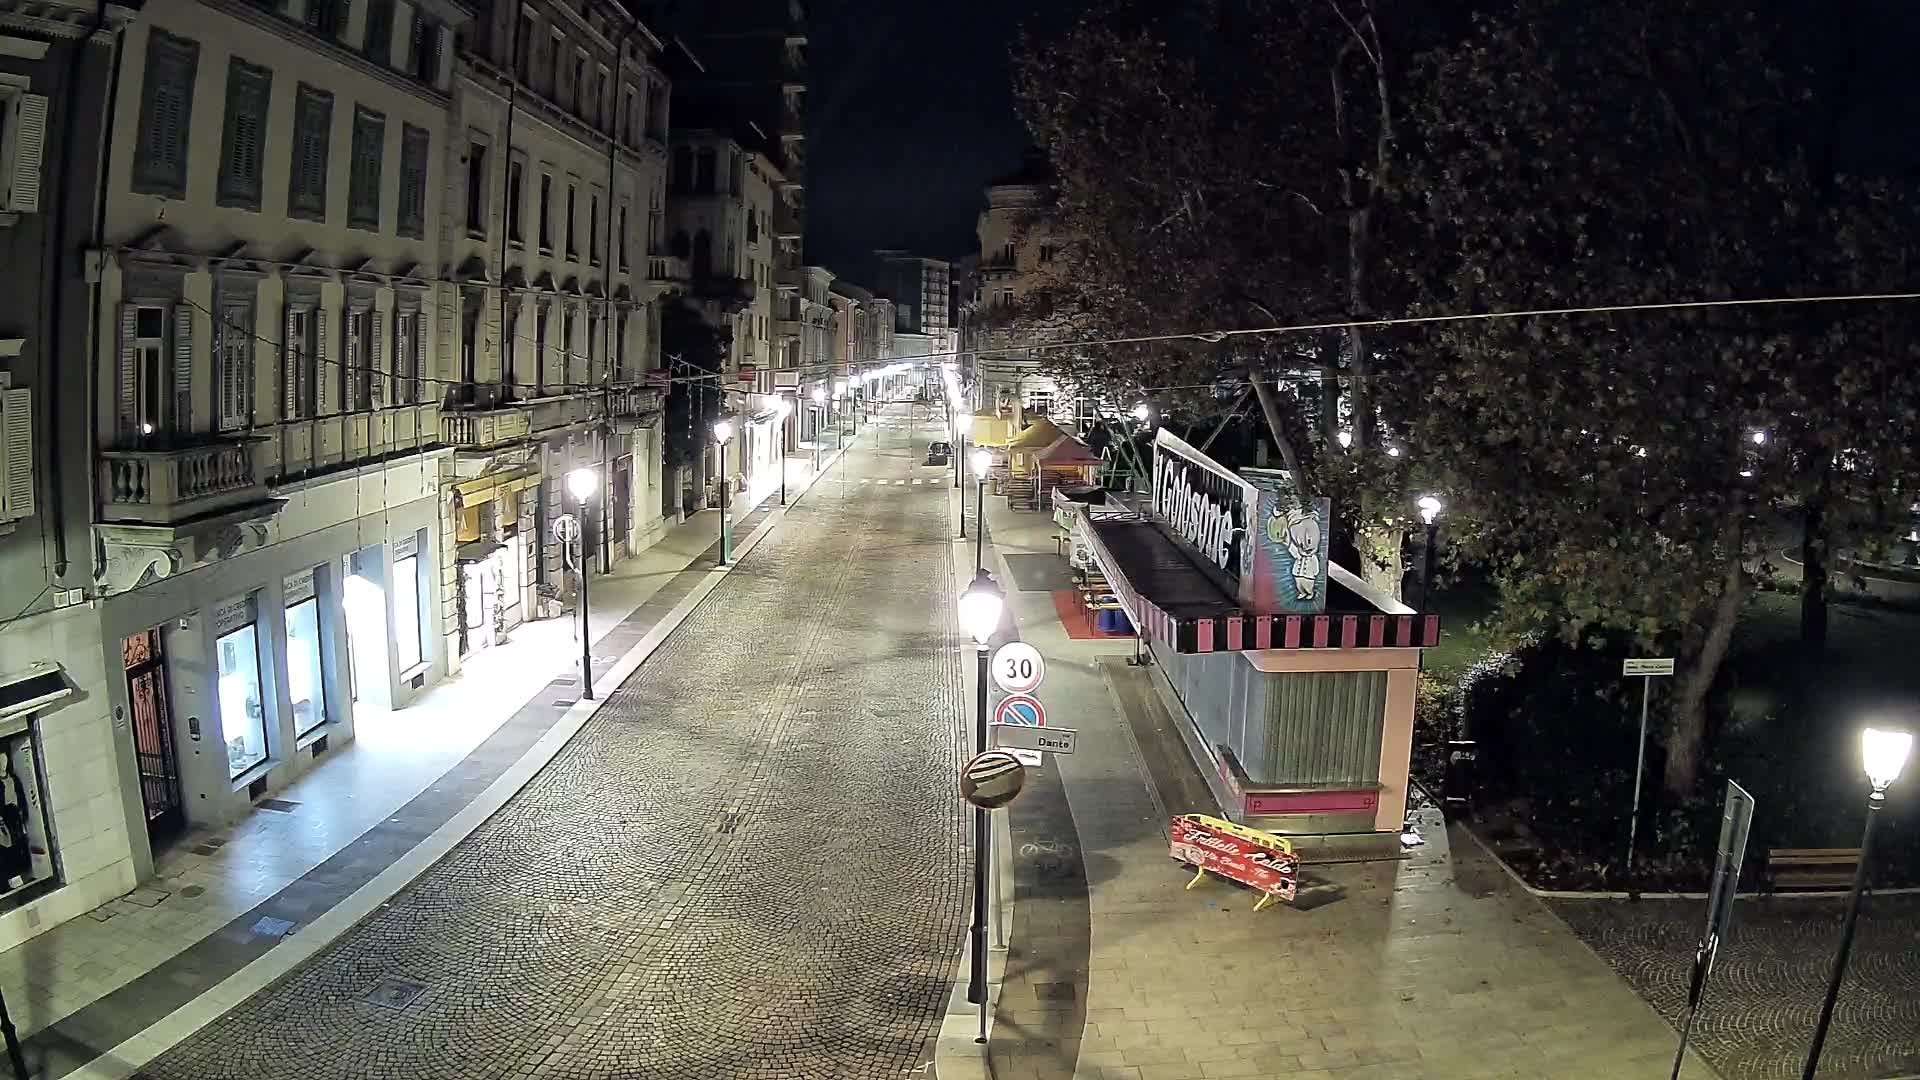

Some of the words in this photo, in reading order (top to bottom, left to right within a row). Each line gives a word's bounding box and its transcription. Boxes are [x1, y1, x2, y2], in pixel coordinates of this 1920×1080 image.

[1162, 458, 1233, 570] Golosone
[1006, 658, 1032, 679] 30
[1038, 737, 1070, 750] Dante
